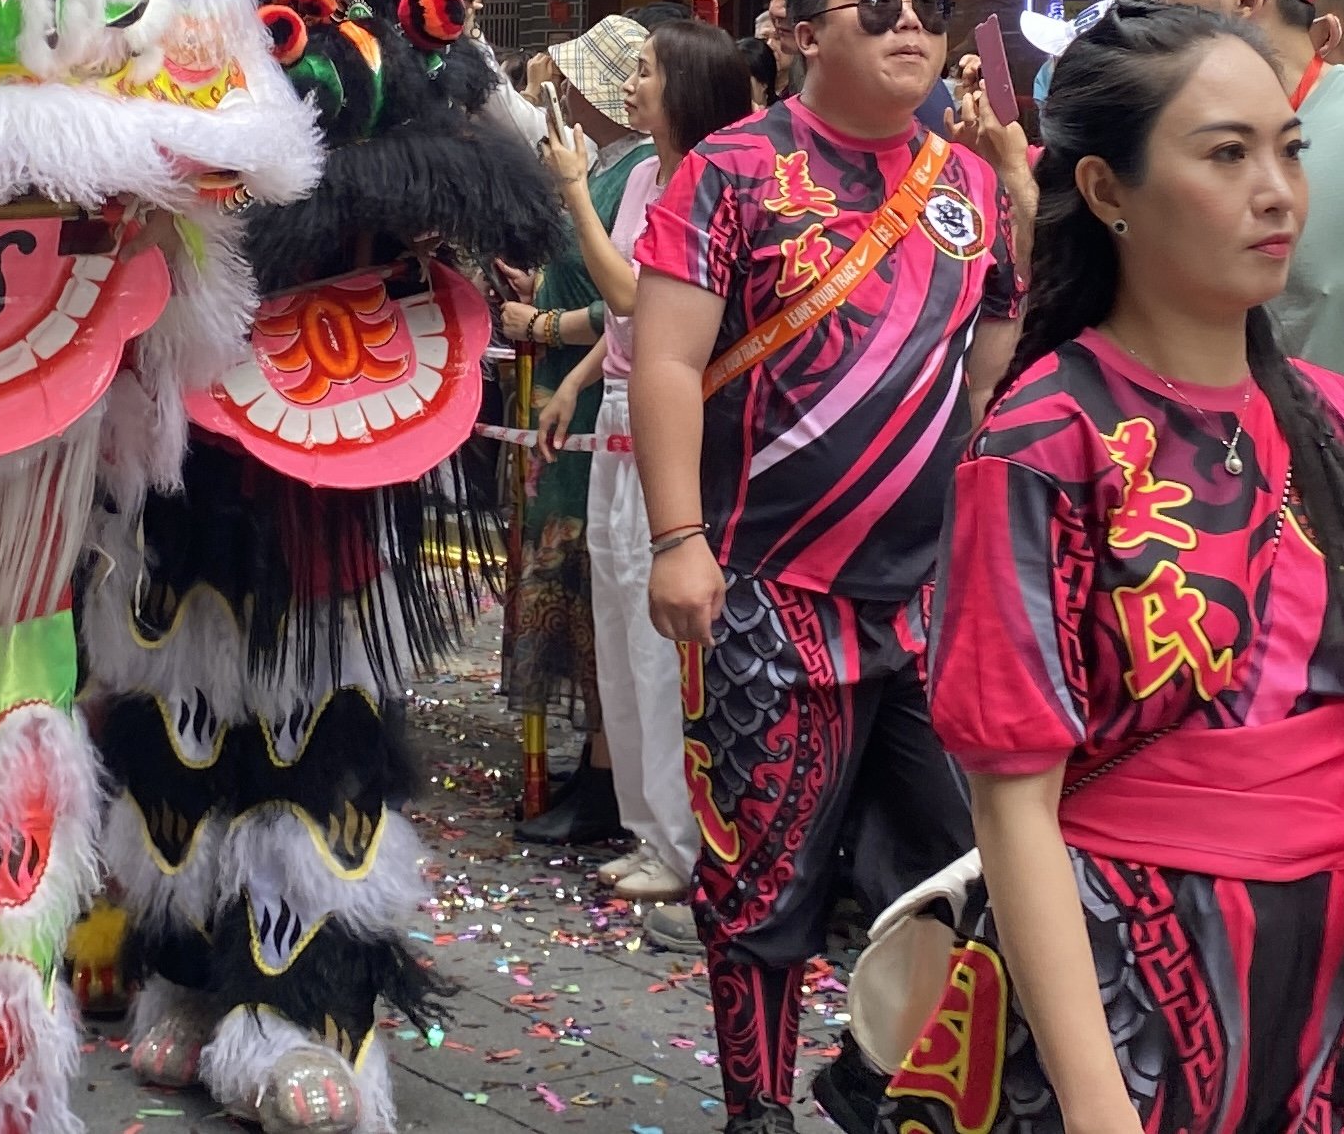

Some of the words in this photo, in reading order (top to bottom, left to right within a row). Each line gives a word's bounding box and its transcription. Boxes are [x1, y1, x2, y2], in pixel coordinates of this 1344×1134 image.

[784, 301, 816, 329] LEAVE
[810, 281, 839, 310] YOUR
[831, 261, 861, 294] TRACE
